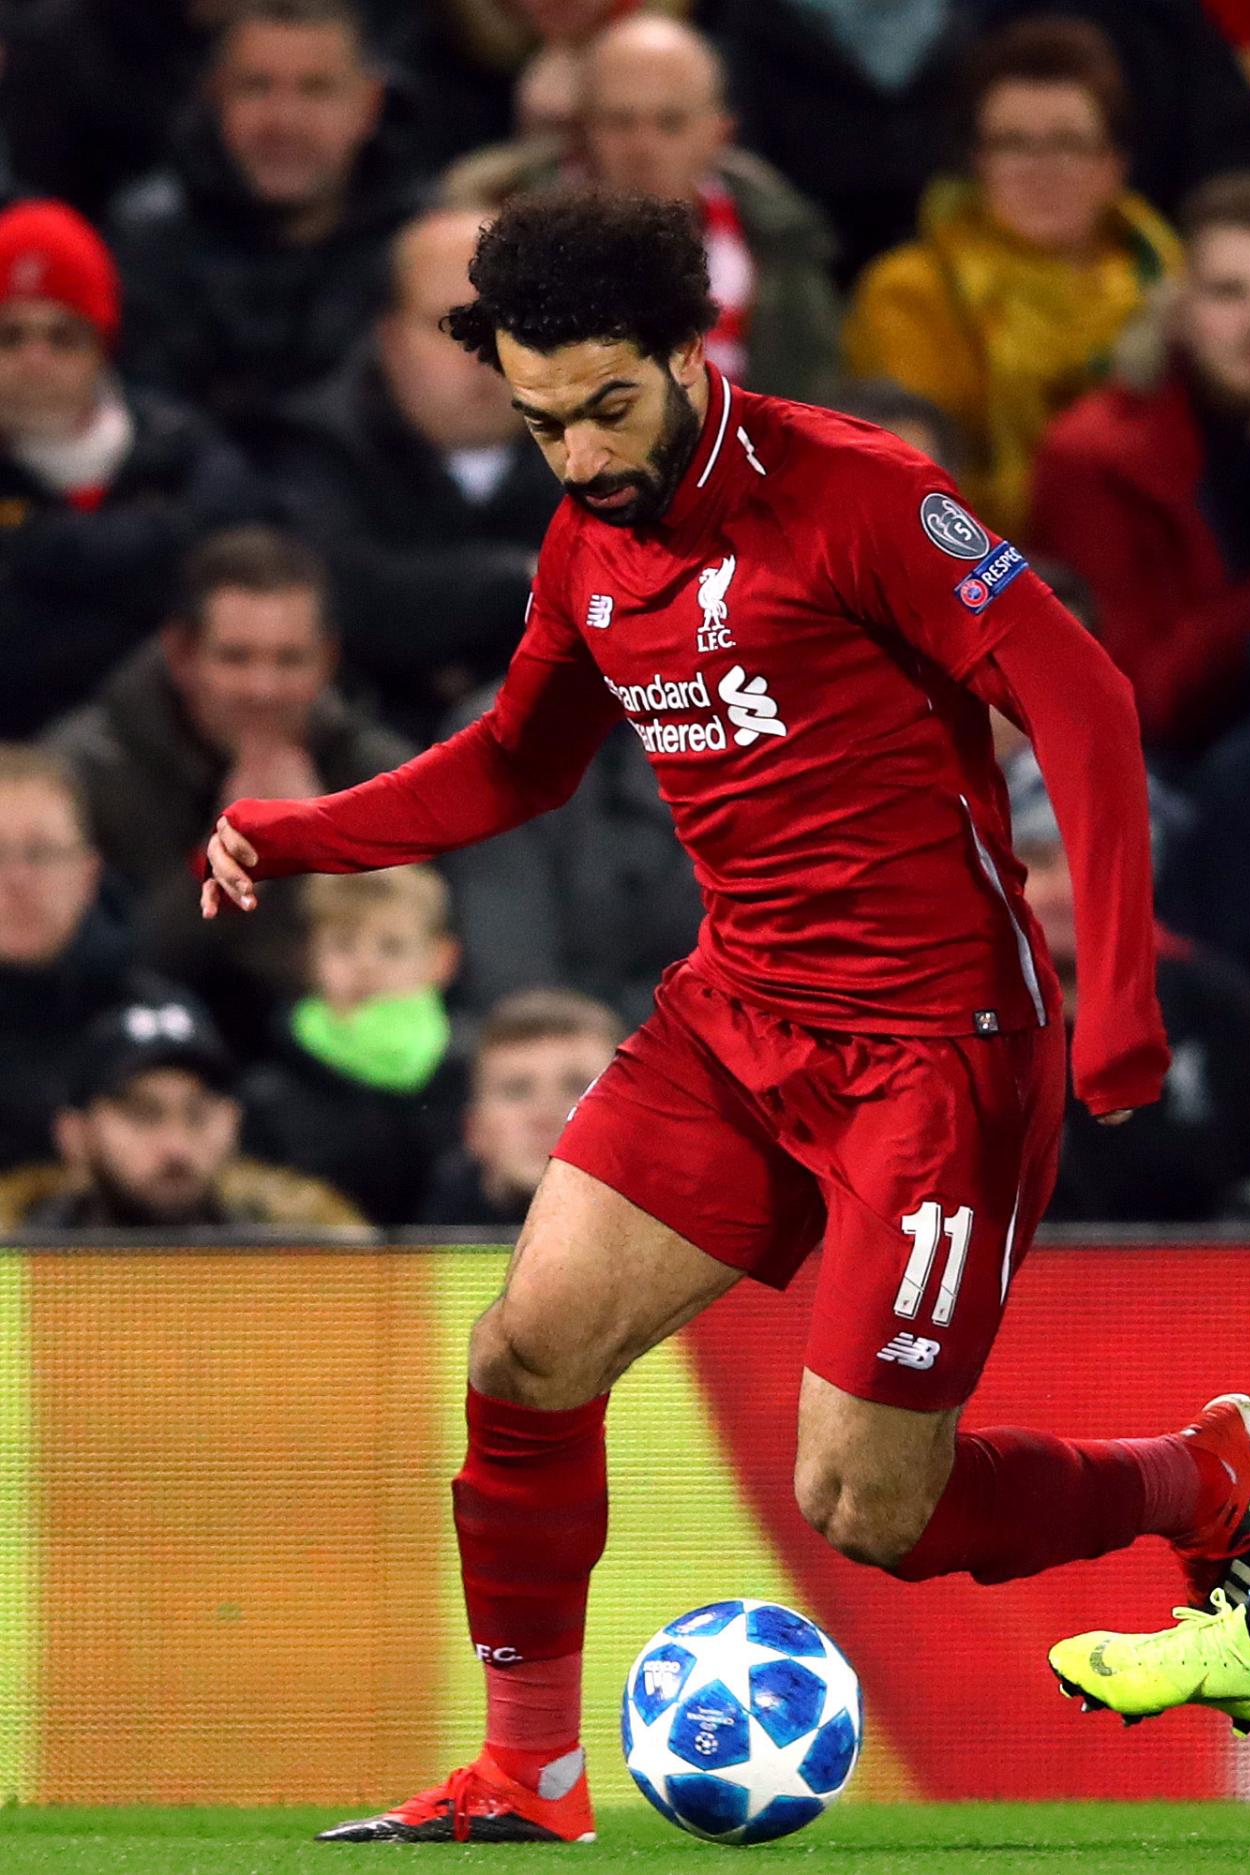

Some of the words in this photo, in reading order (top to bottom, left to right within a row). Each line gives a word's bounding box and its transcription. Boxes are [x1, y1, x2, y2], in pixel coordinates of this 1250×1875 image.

[954, 521, 972, 541] 5
[981, 546, 1024, 587] RESPEC
[894, 1201, 974, 1327] 11
